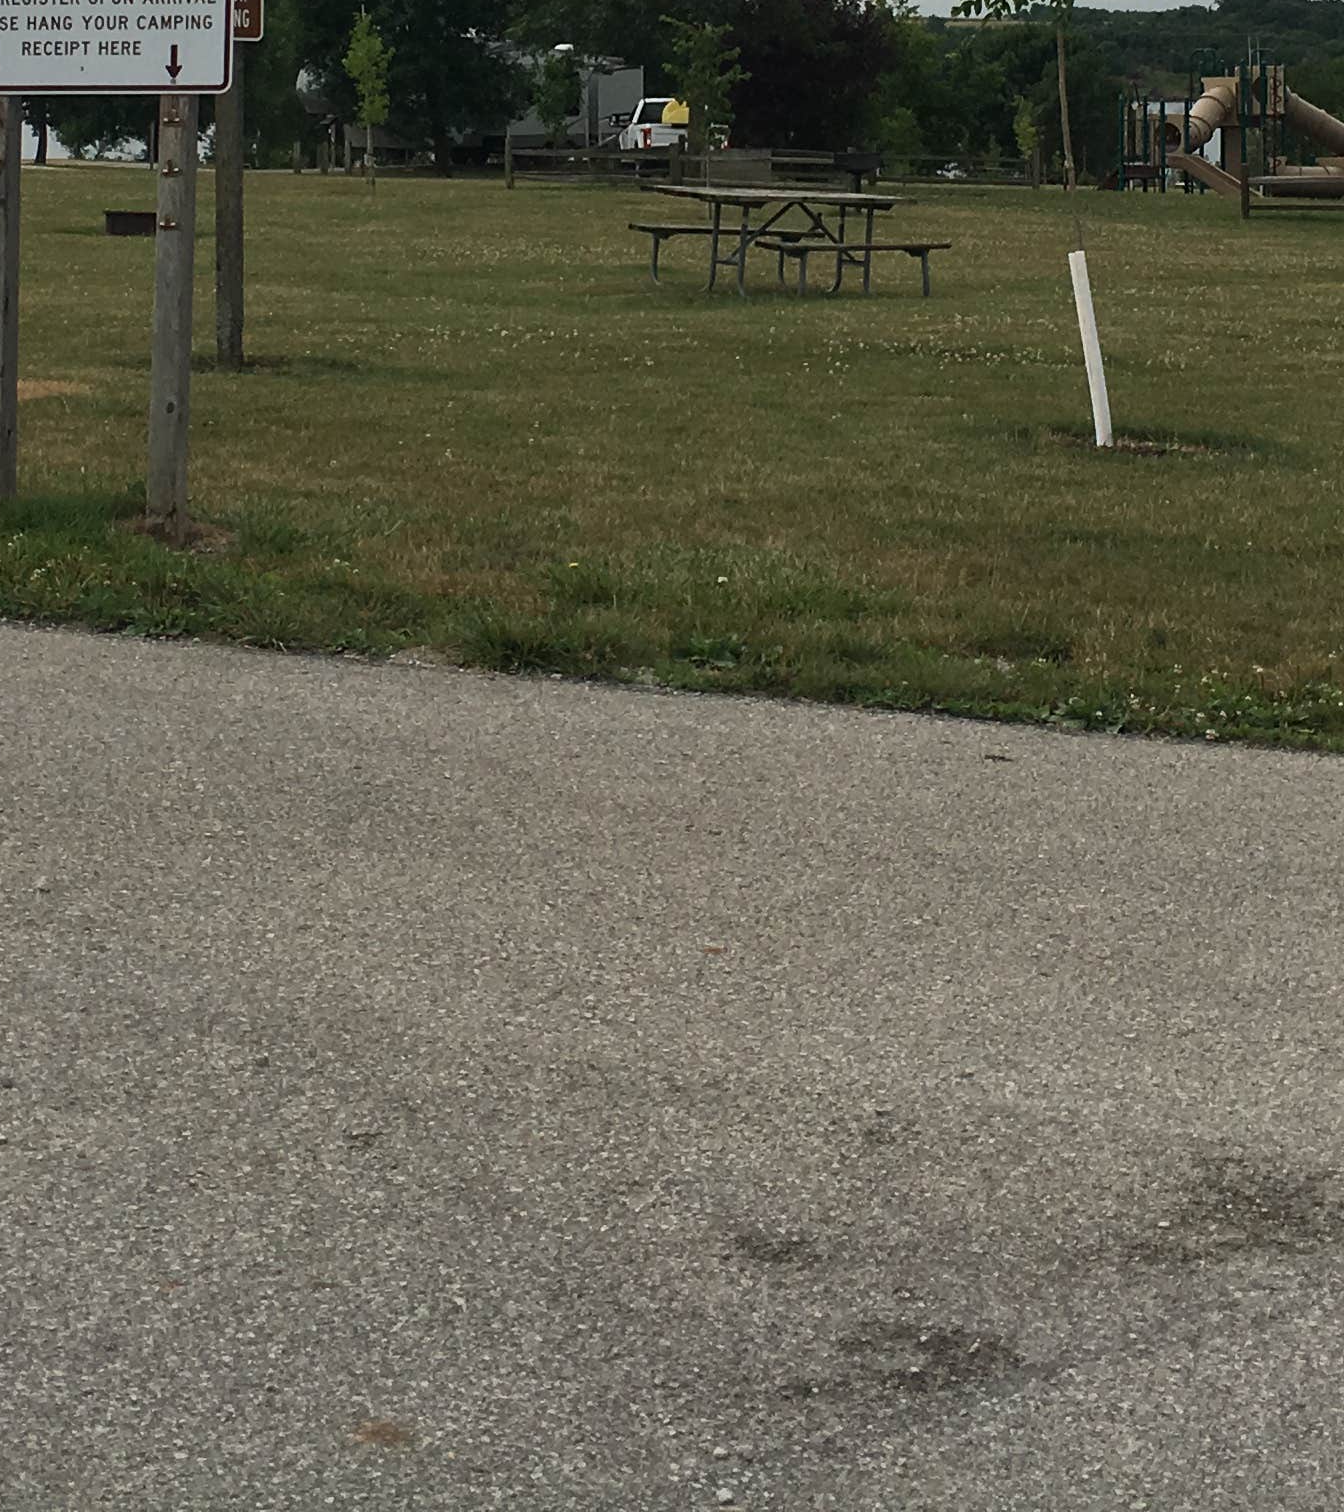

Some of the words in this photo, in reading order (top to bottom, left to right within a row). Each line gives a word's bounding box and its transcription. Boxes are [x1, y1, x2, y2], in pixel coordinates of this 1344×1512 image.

[27, 16, 73, 31] HANG
[82, 15, 128, 30] YOUR
[136, 15, 213, 30] CAMPING
[22, 41, 90, 56] RECEIPT
[98, 41, 142, 55] HERE
